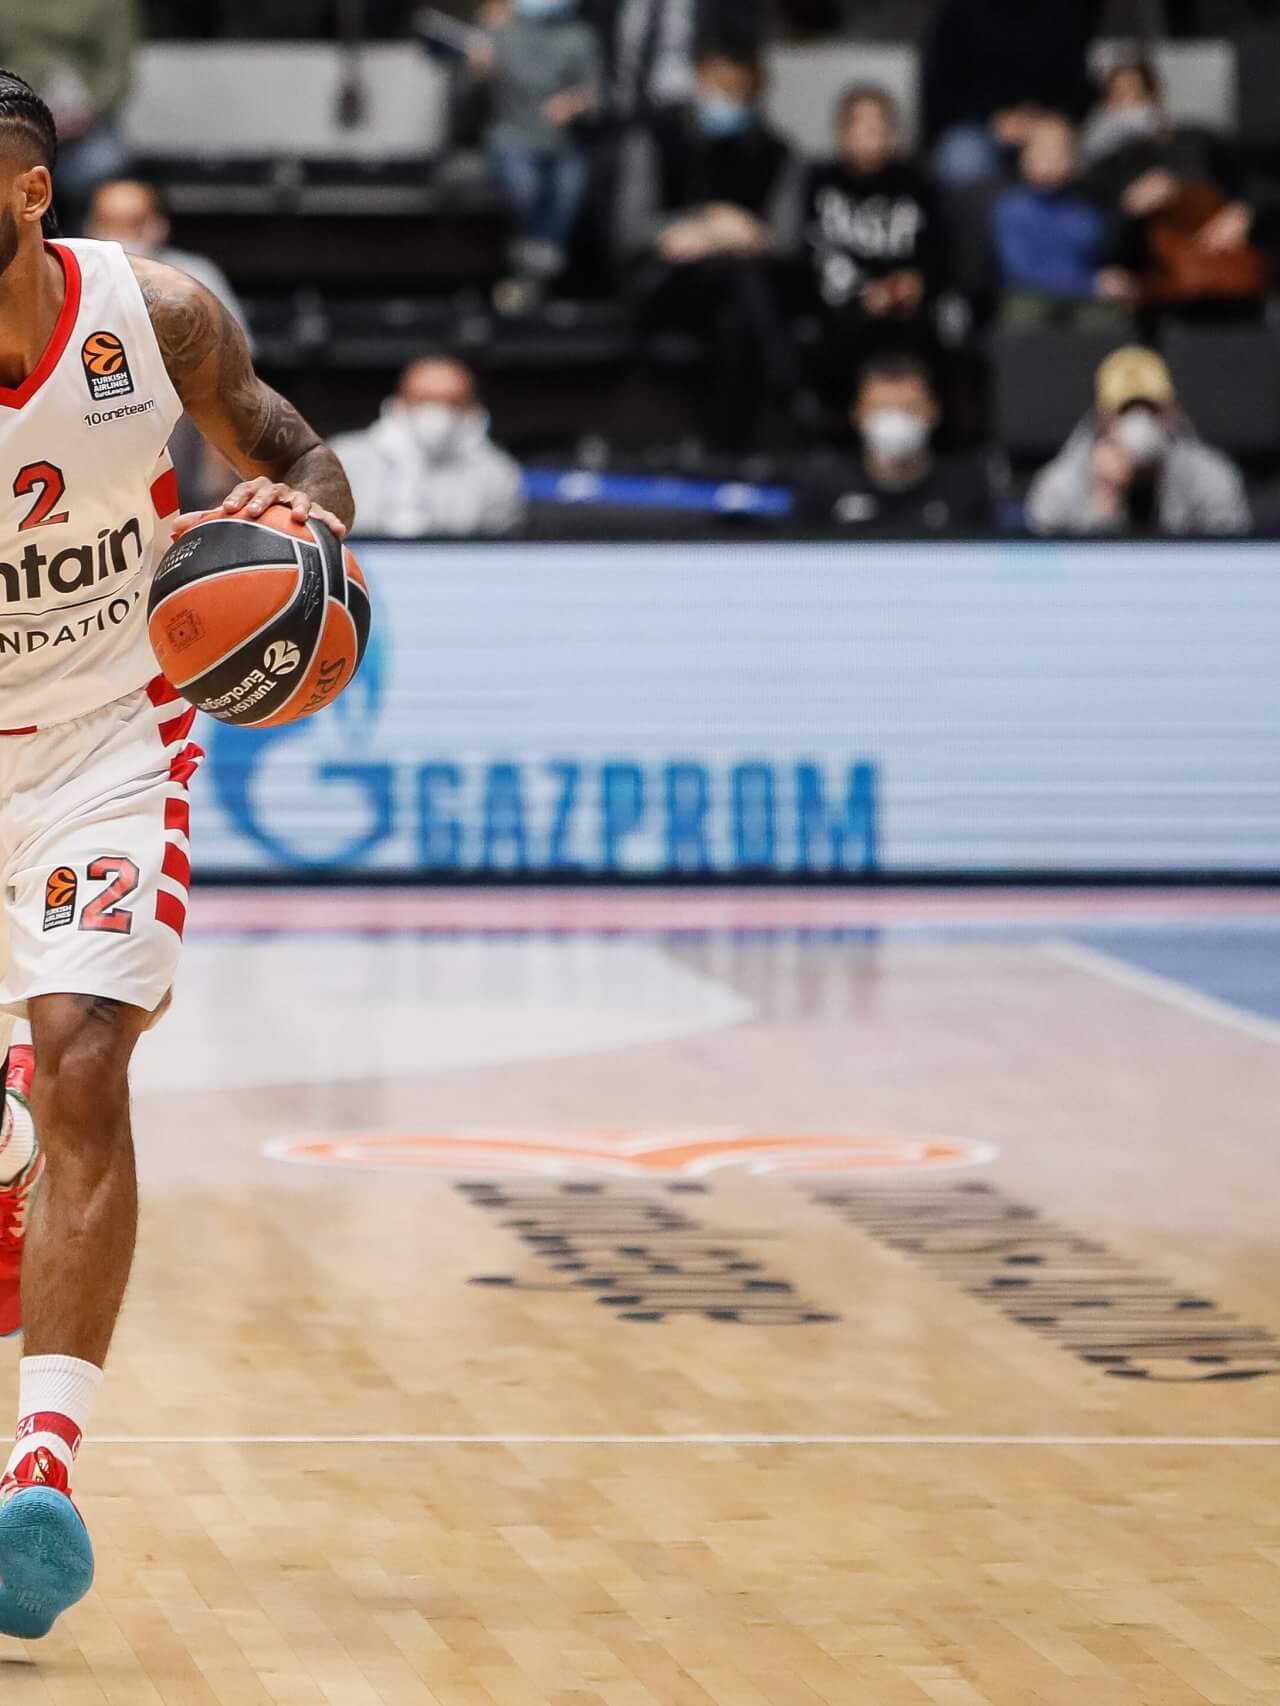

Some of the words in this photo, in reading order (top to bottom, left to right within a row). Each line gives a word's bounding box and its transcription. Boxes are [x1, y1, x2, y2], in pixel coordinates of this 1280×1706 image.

[92, 372, 128, 385] TURKISH
[93, 379, 130, 393] AIRLINES
[12, 460, 70, 532] 2
[228, 679, 278, 714] TURKISH
[417, 759, 876, 870] GAZPROM
[78, 855, 140, 935] 2
